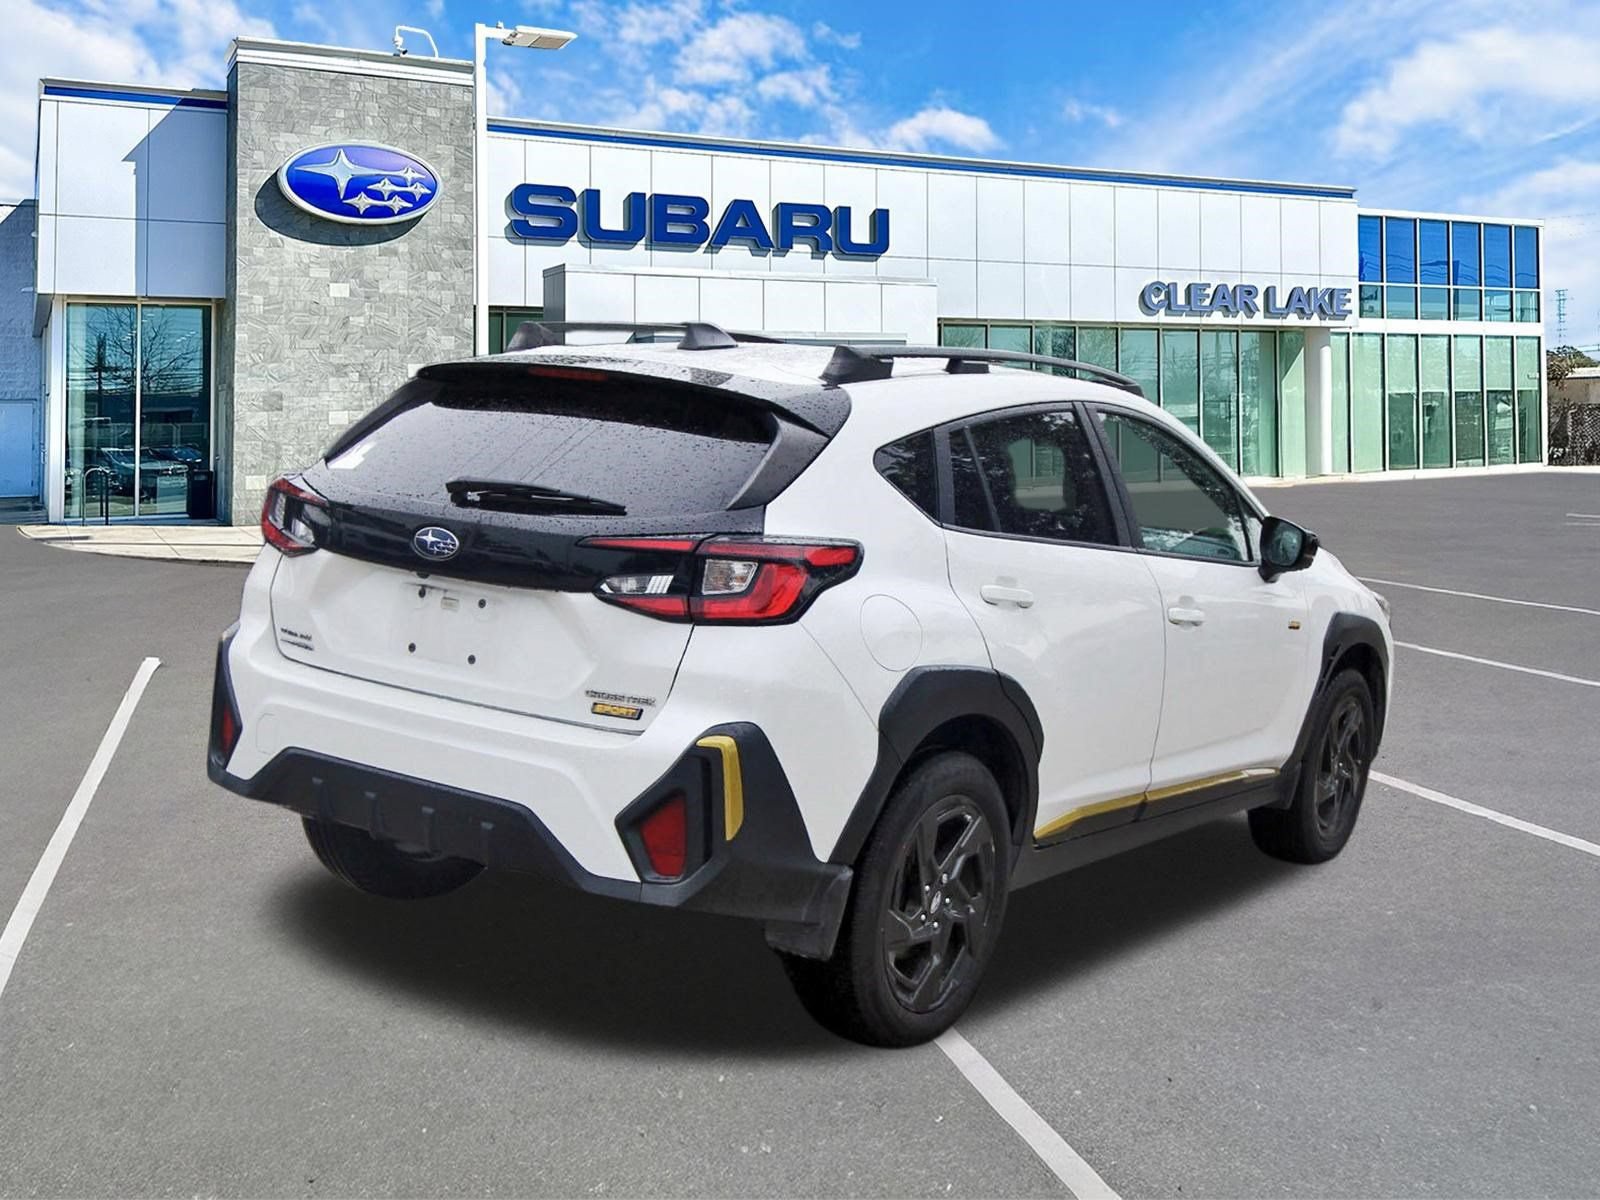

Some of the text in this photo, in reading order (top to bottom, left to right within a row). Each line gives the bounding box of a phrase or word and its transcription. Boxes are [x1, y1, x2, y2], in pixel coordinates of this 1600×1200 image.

[505, 183, 890, 261] SUBARU
[1139, 281, 1353, 320] CLEAR LAKE
